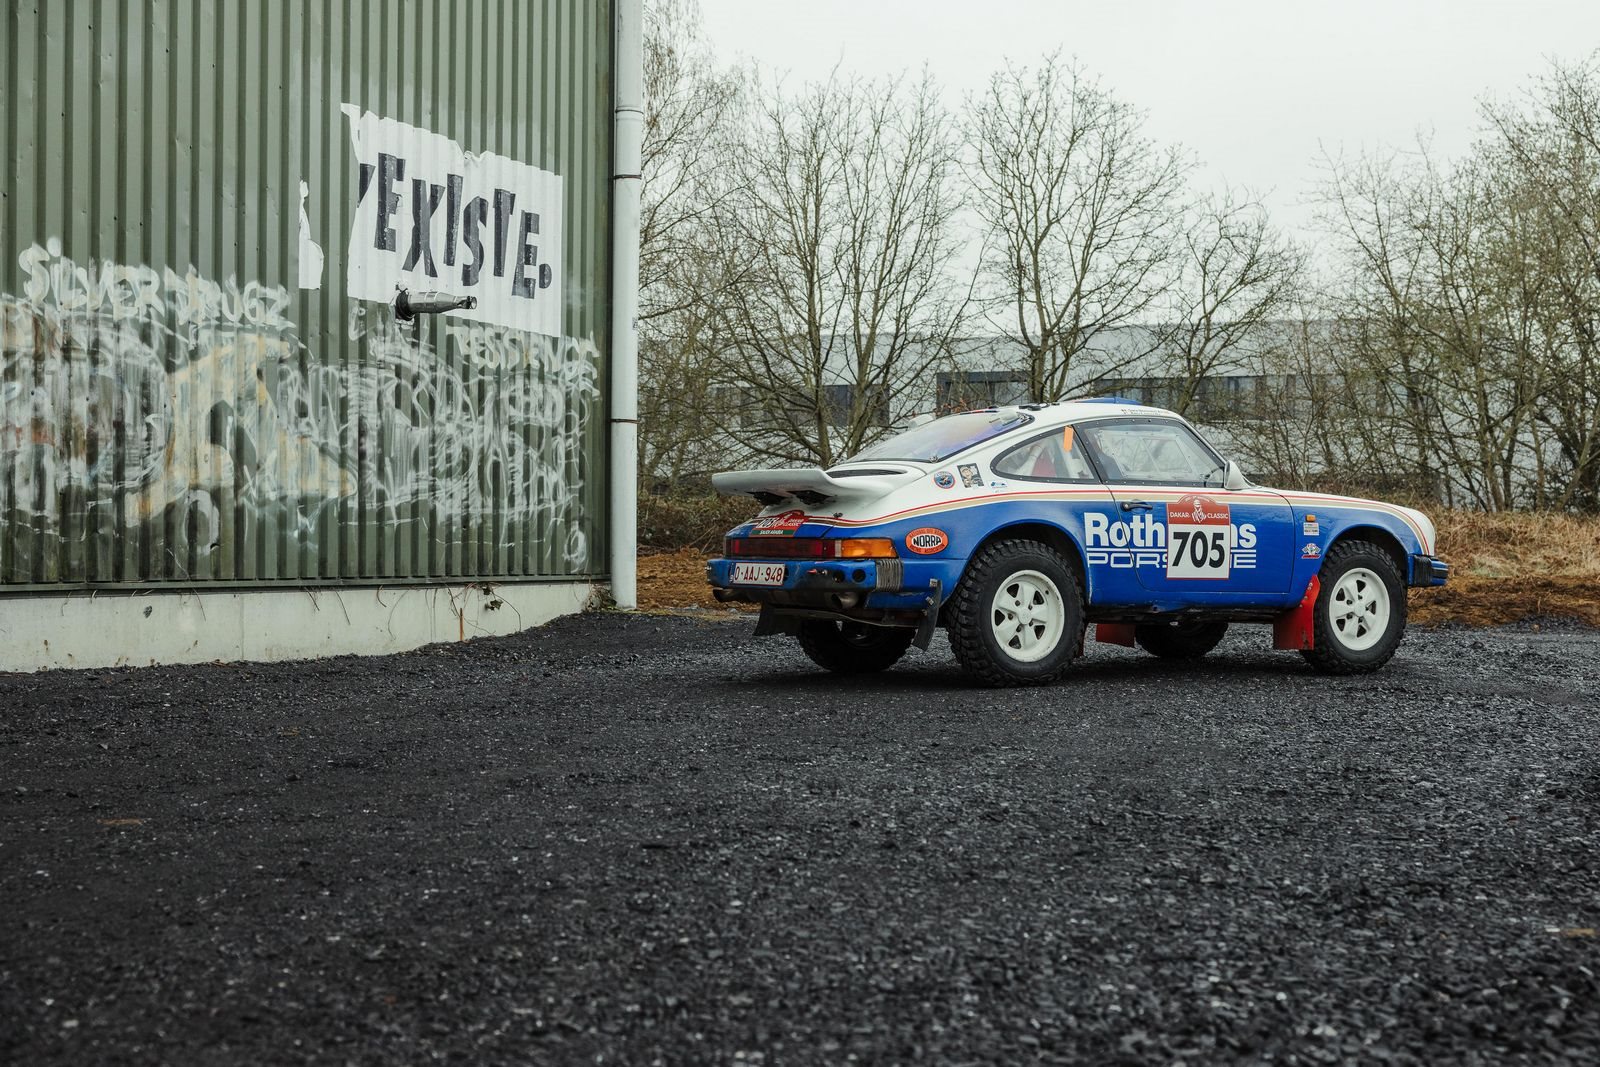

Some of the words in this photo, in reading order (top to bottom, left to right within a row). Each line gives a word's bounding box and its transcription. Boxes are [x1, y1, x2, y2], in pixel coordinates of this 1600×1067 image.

[912, 534, 942, 548] NORRA
[1083, 511, 1257, 549] Roths
[1086, 552, 1257, 569] PORE
[1172, 530, 1226, 569] 705
